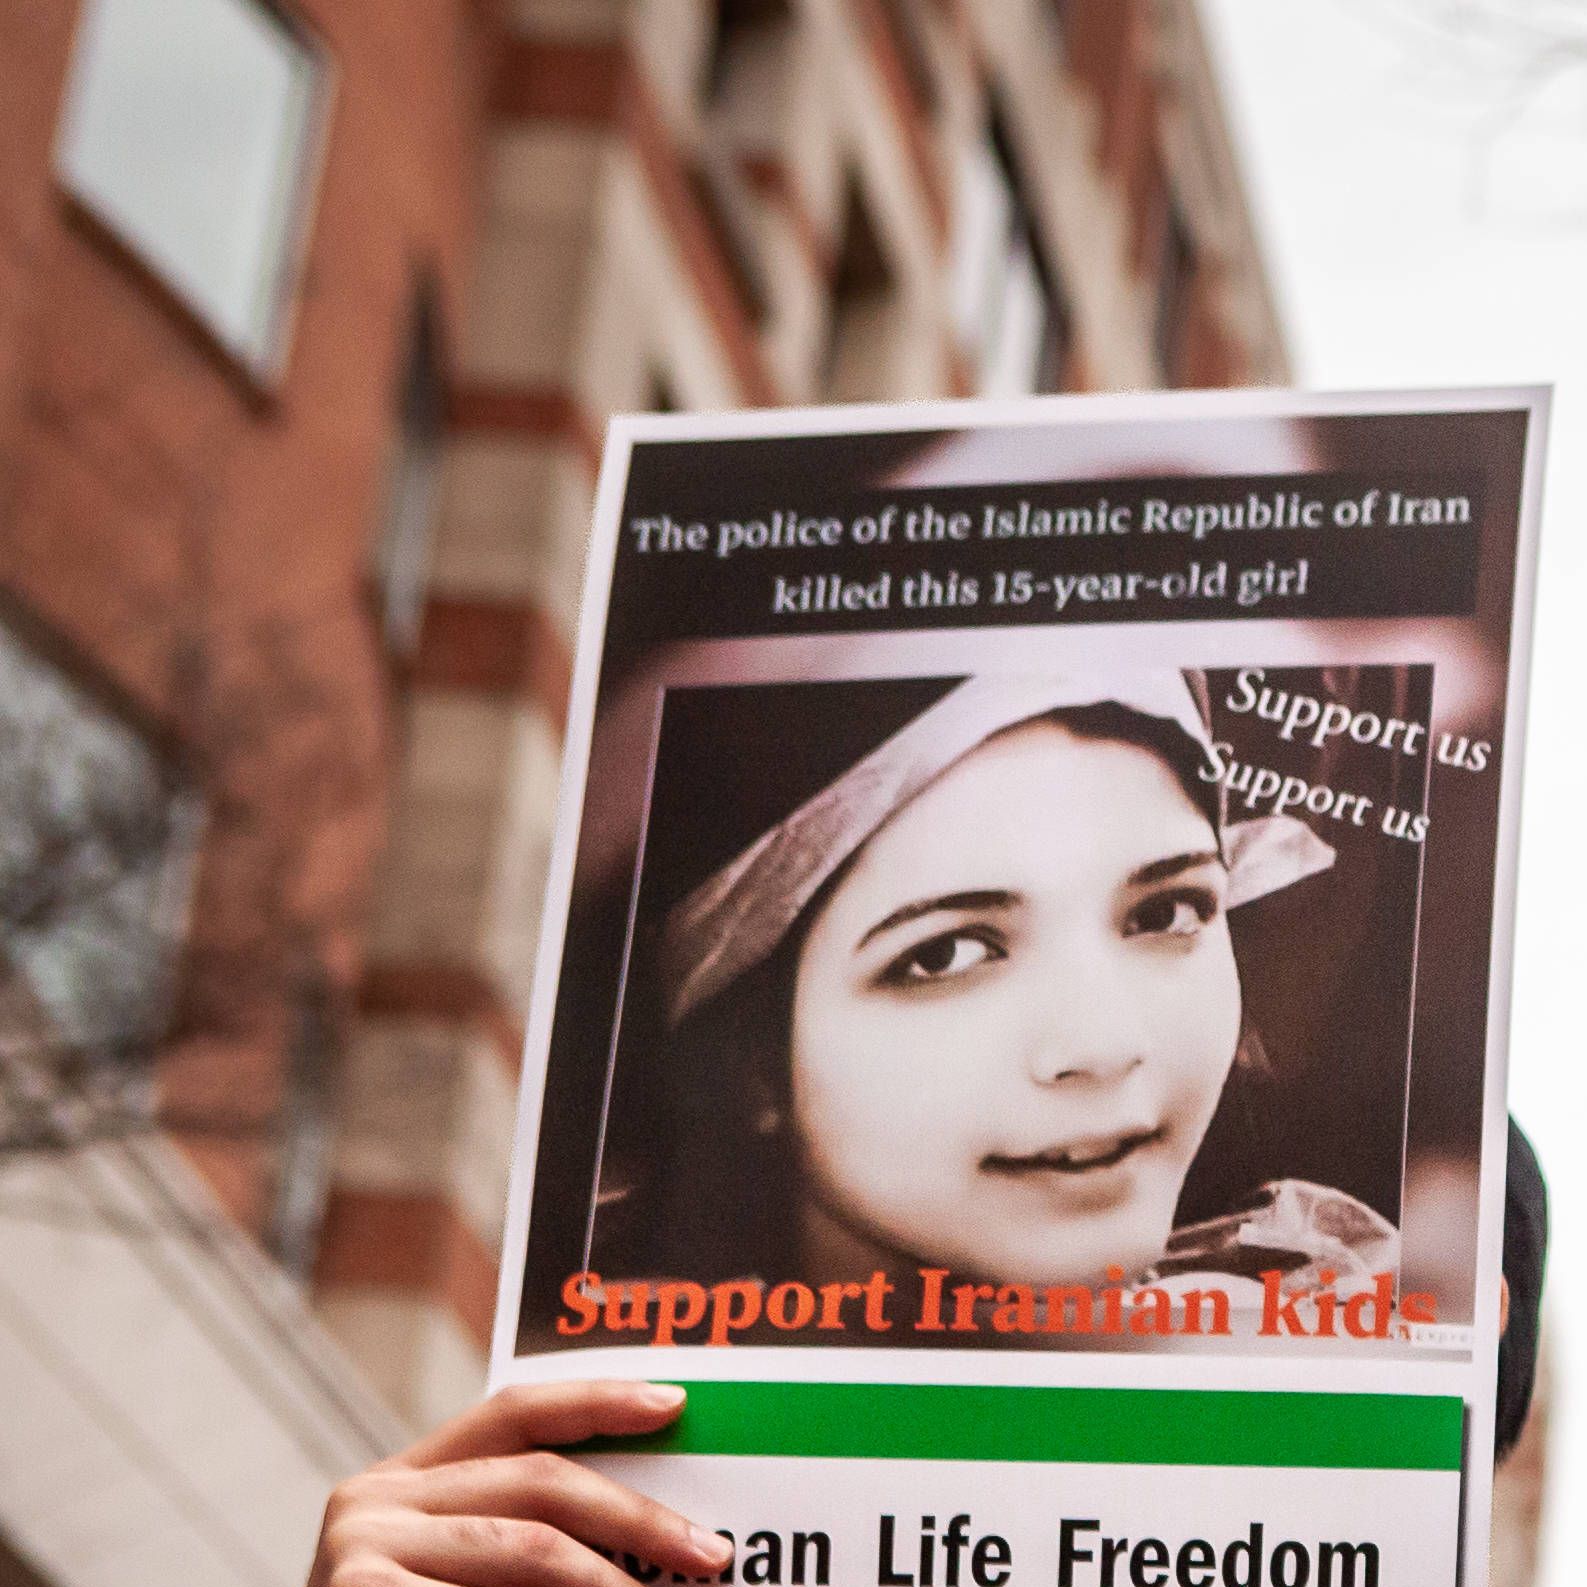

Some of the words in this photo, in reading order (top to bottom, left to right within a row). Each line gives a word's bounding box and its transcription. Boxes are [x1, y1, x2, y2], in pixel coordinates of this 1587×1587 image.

[631, 512, 708, 554] The
[717, 509, 843, 558] police
[852, 505, 898, 545] of
[904, 504, 971, 542] the
[982, 501, 1131, 539] Islamic
[1142, 492, 1322, 540] Republic
[1333, 489, 1378, 527] of
[1389, 492, 1471, 525] Iran
[772, 573, 891, 614] killed
[902, 570, 979, 607] this
[993, 561, 1227, 610] 15-year-old
[1238, 559, 1309, 607] girl
[1226, 667, 1425, 755] Support
[1437, 732, 1491, 773] us
[1199, 741, 1374, 827] Support
[1382, 806, 1431, 843] us
[556, 1270, 895, 1347] Support
[914, 1264, 1232, 1335] Iranian
[1257, 1269, 1437, 1340] kids
